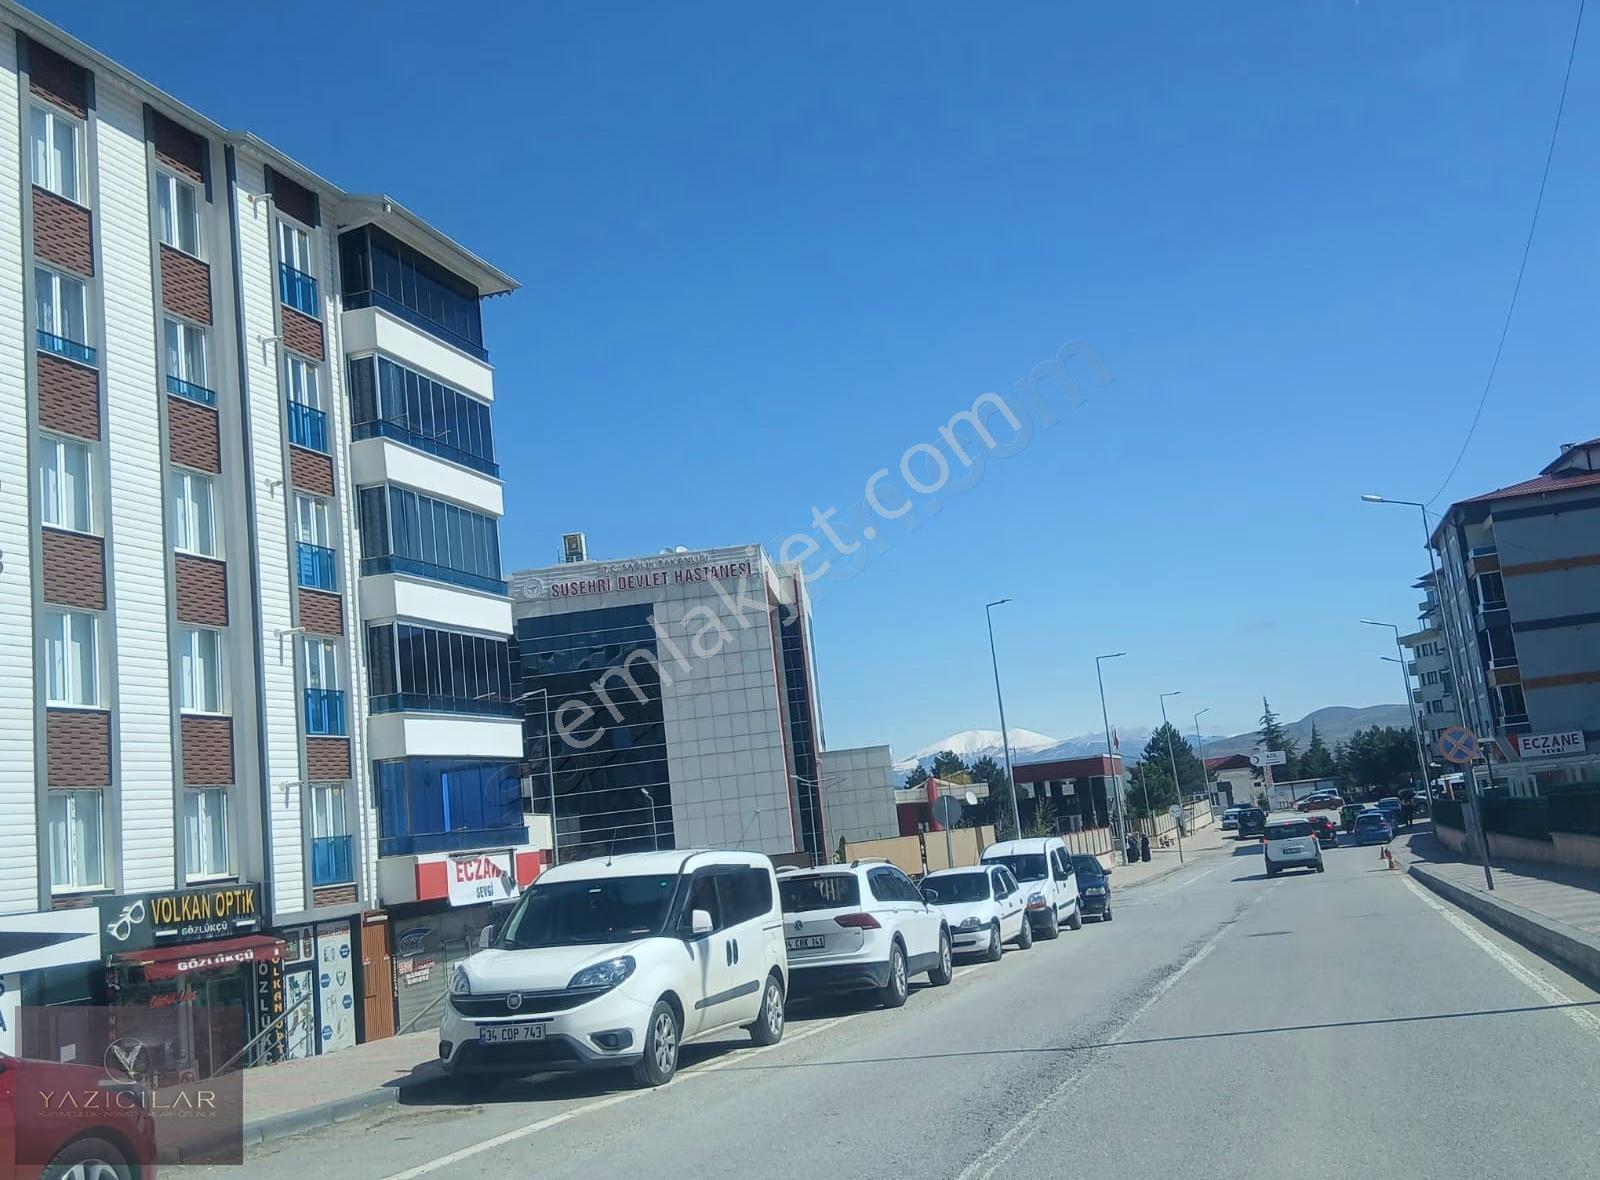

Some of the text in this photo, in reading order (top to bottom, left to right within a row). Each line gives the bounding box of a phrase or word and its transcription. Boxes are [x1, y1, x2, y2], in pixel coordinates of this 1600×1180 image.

[618, 571, 668, 590] DEVLET
[675, 558, 752, 584] HASTANESİ
[1522, 733, 1580, 750] ECZANE
[455, 858, 502, 883] ECZAN
[151, 894, 211, 925] VOLKAN
[181, 920, 228, 936] GÖZLÜKÇÜ
[486, 1029, 497, 1041] 34
[524, 1026, 542, 1039] 743
